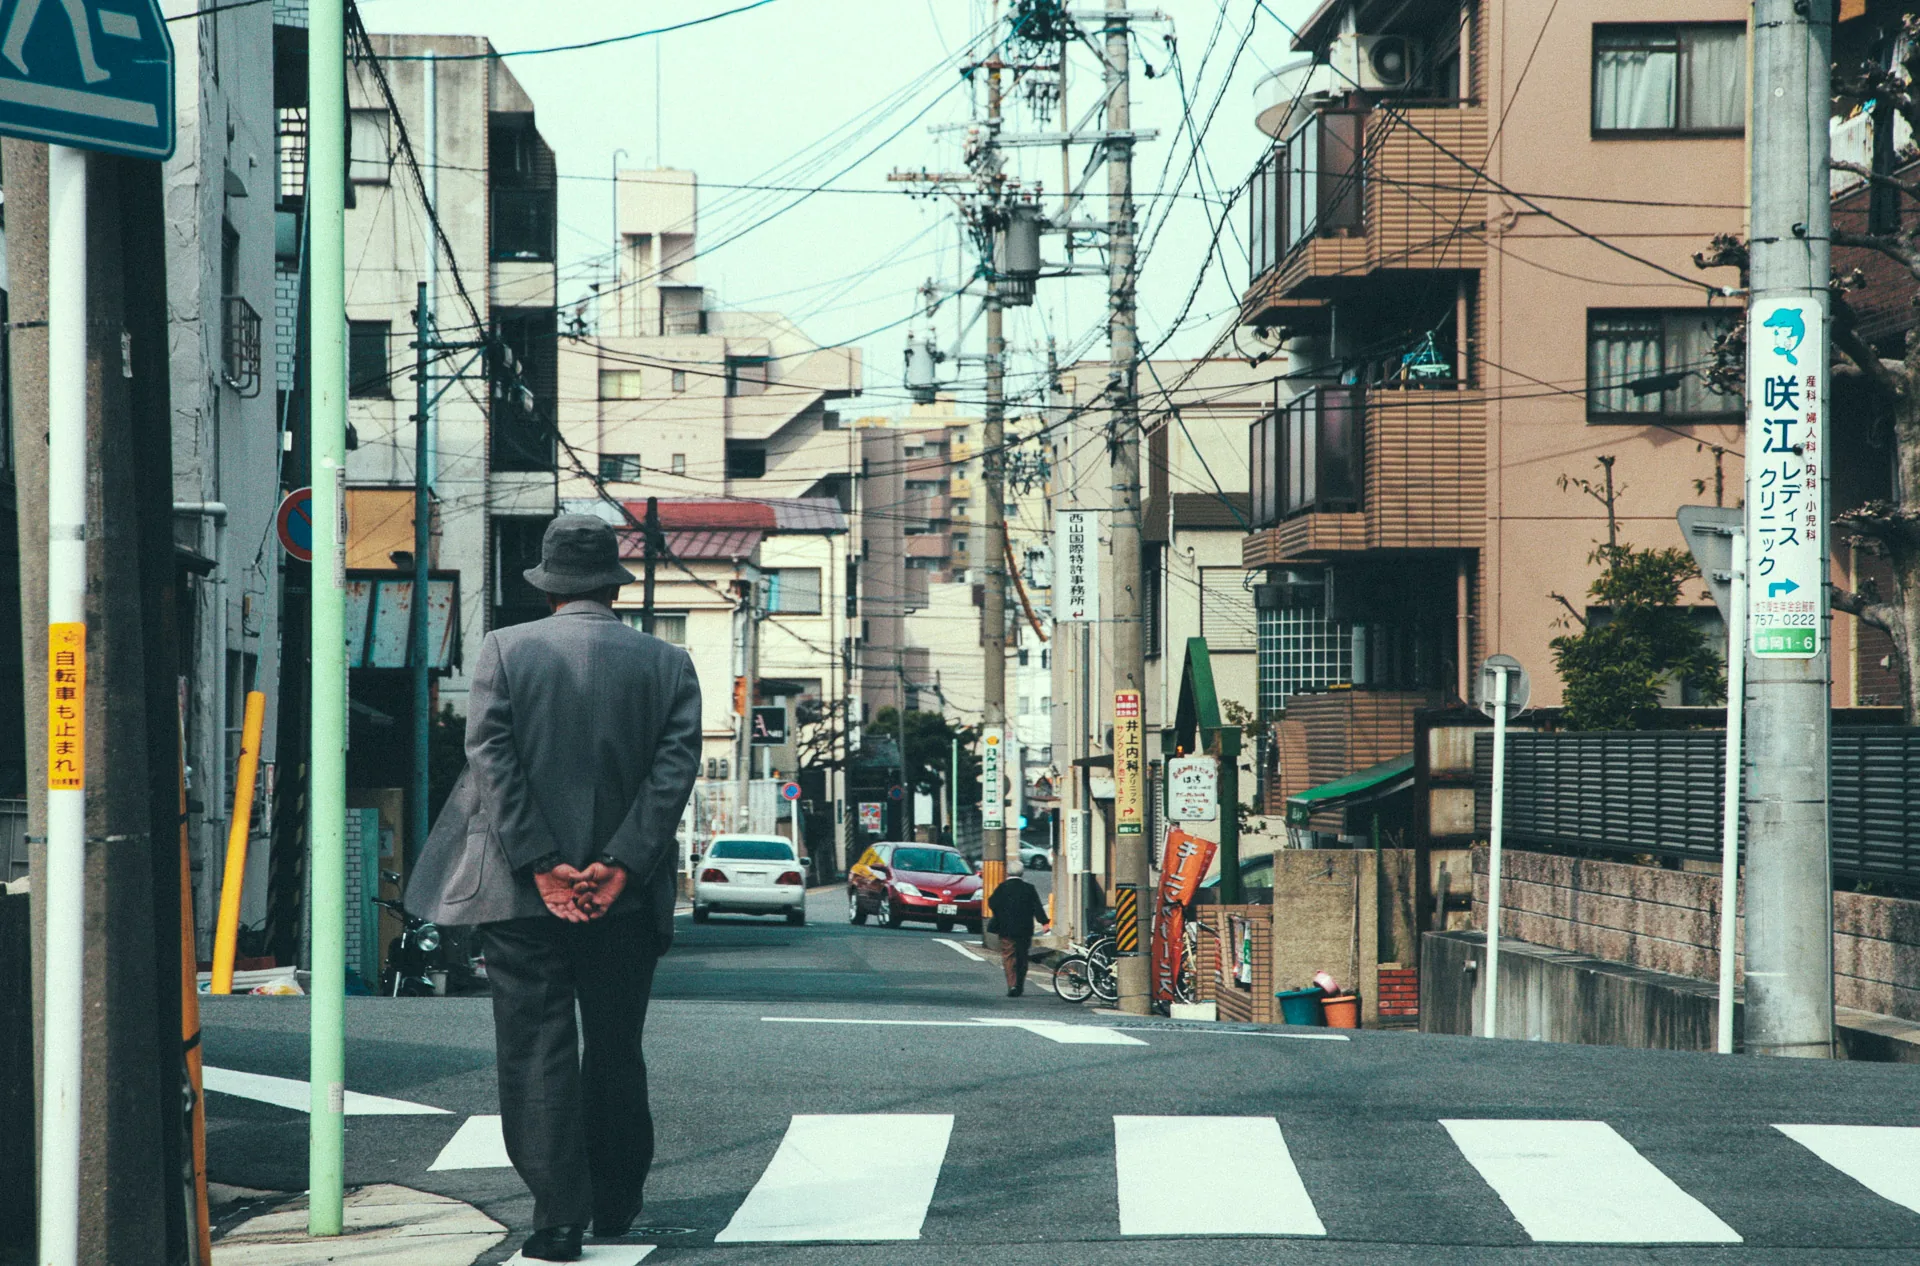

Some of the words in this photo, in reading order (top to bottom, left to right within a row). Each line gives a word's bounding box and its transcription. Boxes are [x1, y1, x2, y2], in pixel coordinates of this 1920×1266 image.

[1763, 375, 1799, 453] 咲江
[1758, 468, 1777, 576] クリニック
[1779, 461, 1802, 546] レディス
[1069, 513, 1085, 606] 西山国際特許事務所
[1754, 613, 1816, 626] 757-0222
[55, 650, 77, 772] 自転車も止まれ
